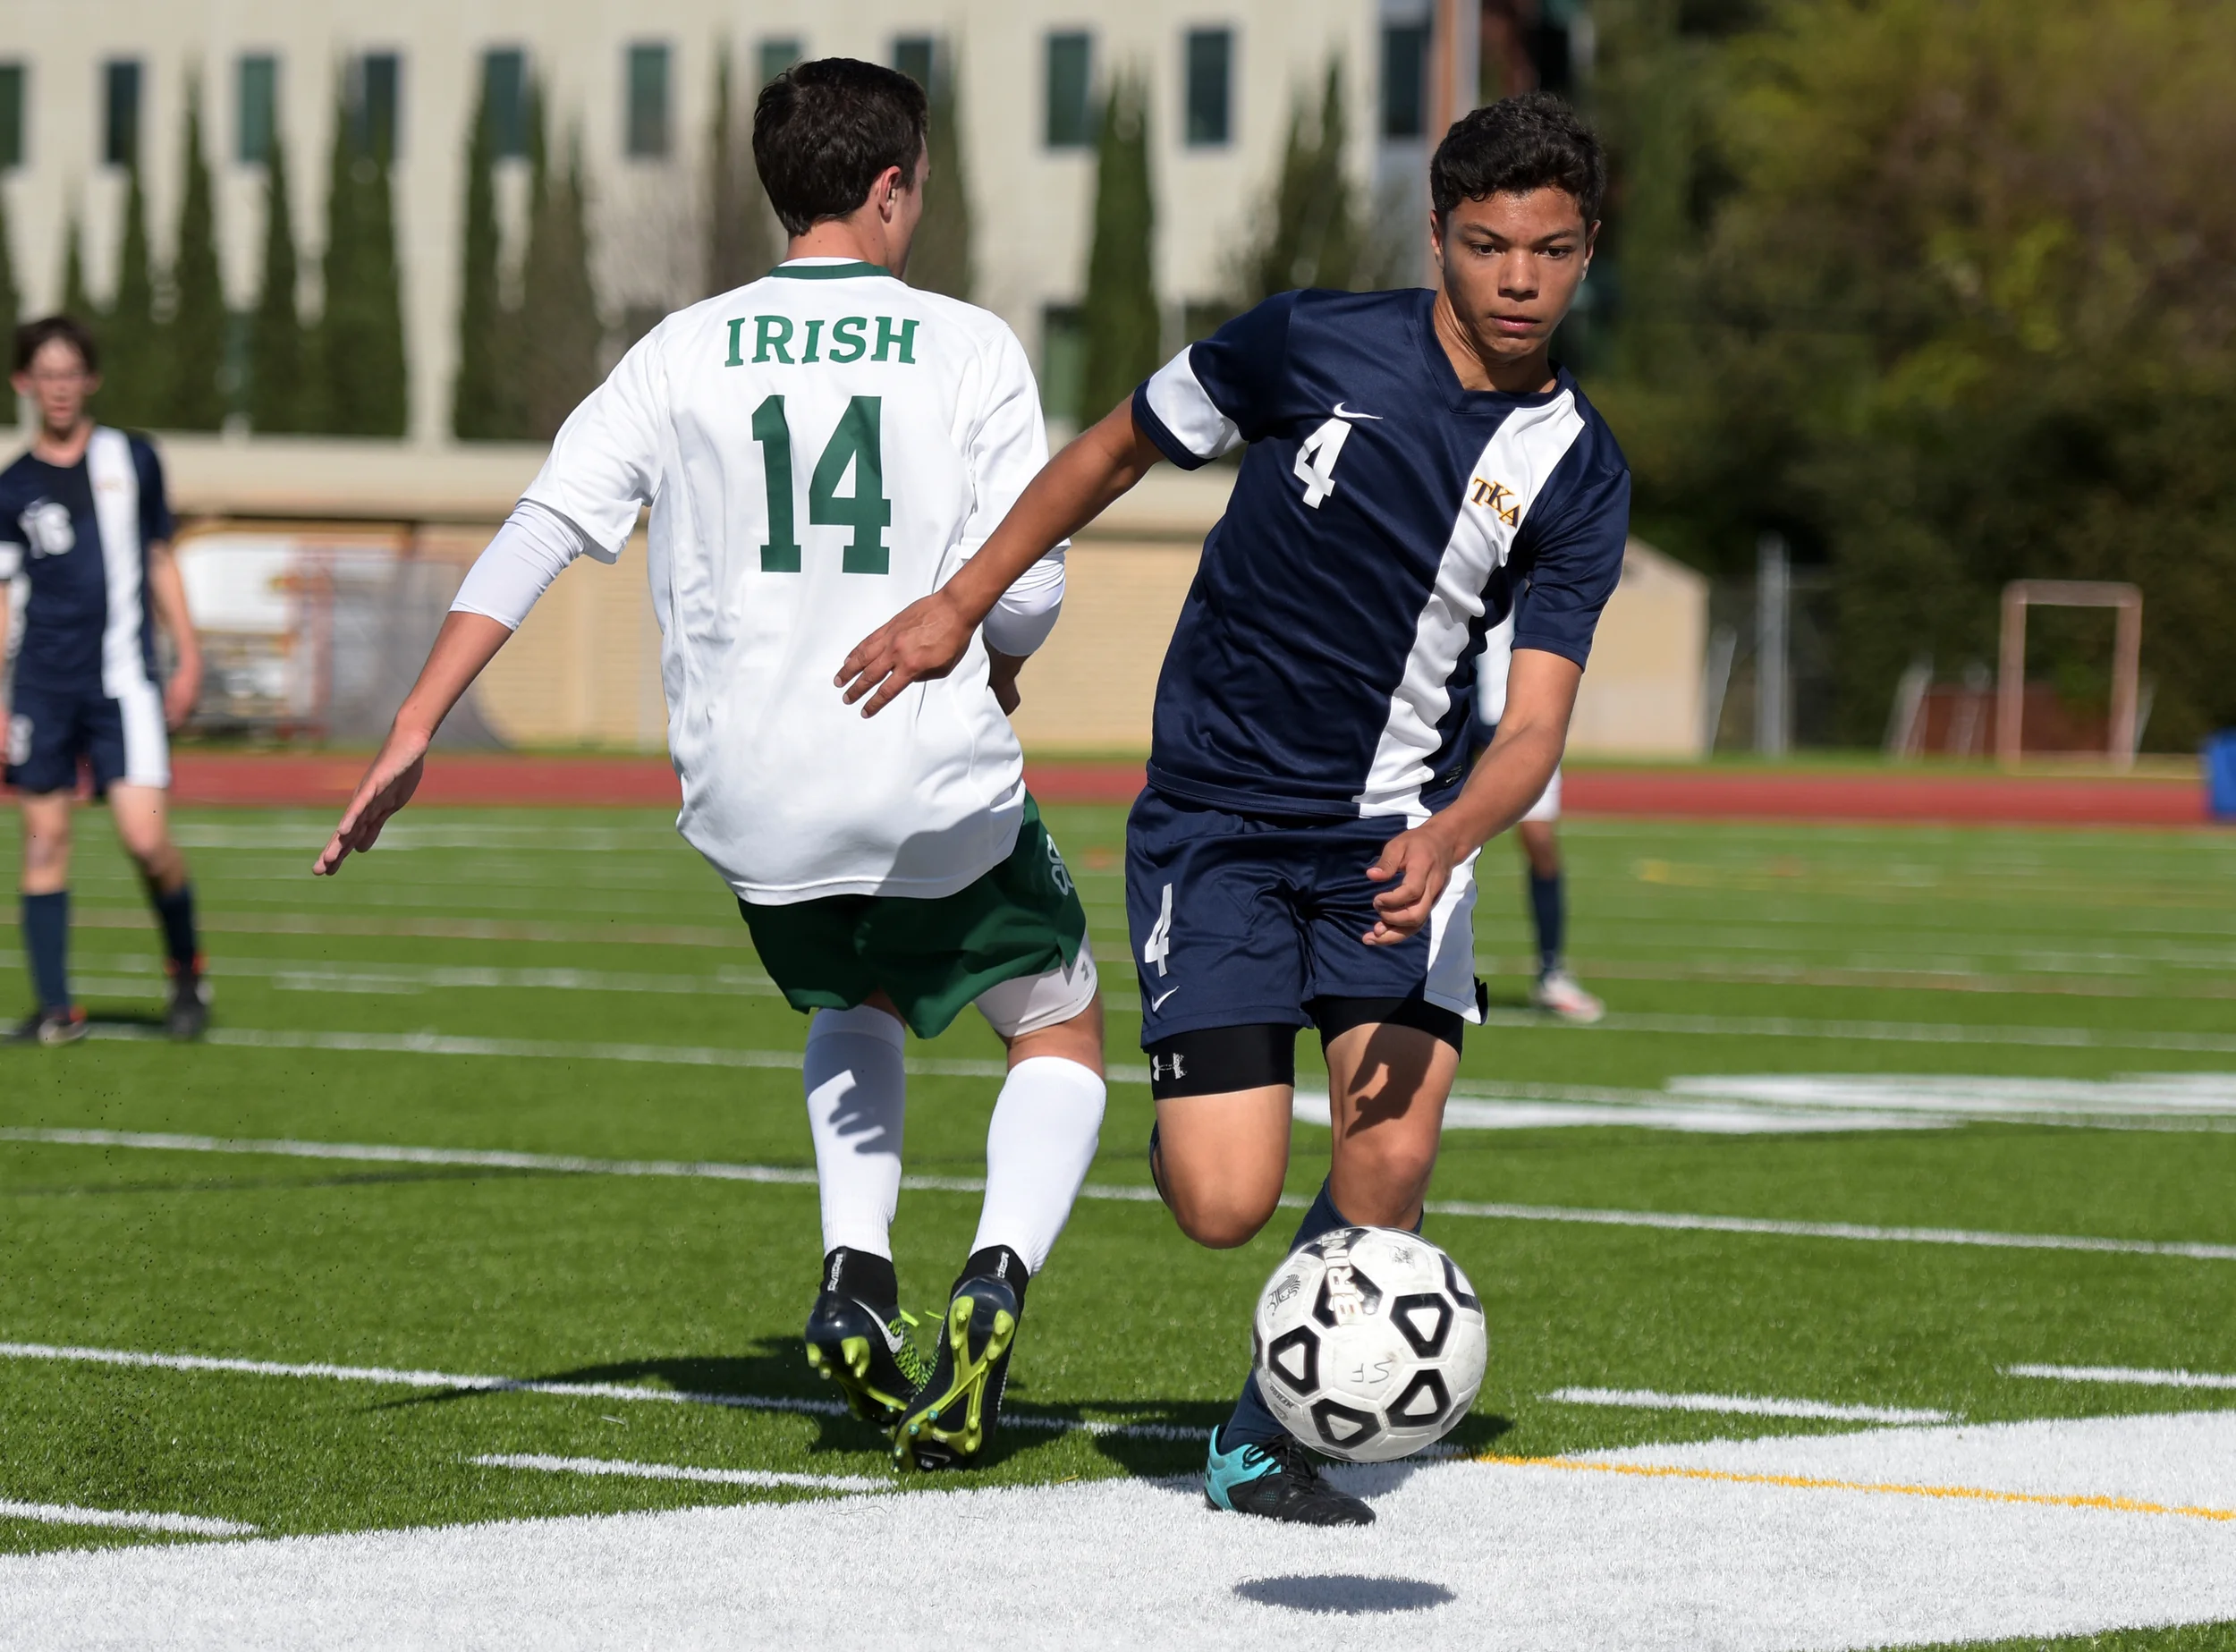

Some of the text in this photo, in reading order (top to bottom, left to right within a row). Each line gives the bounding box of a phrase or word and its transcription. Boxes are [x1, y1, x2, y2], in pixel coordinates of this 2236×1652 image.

[724, 315, 919, 368] IRISH
[751, 394, 892, 575] 14
[1293, 417, 1352, 510] 4
[1470, 477, 1521, 529] TKA
[1144, 883, 1173, 978] 4
